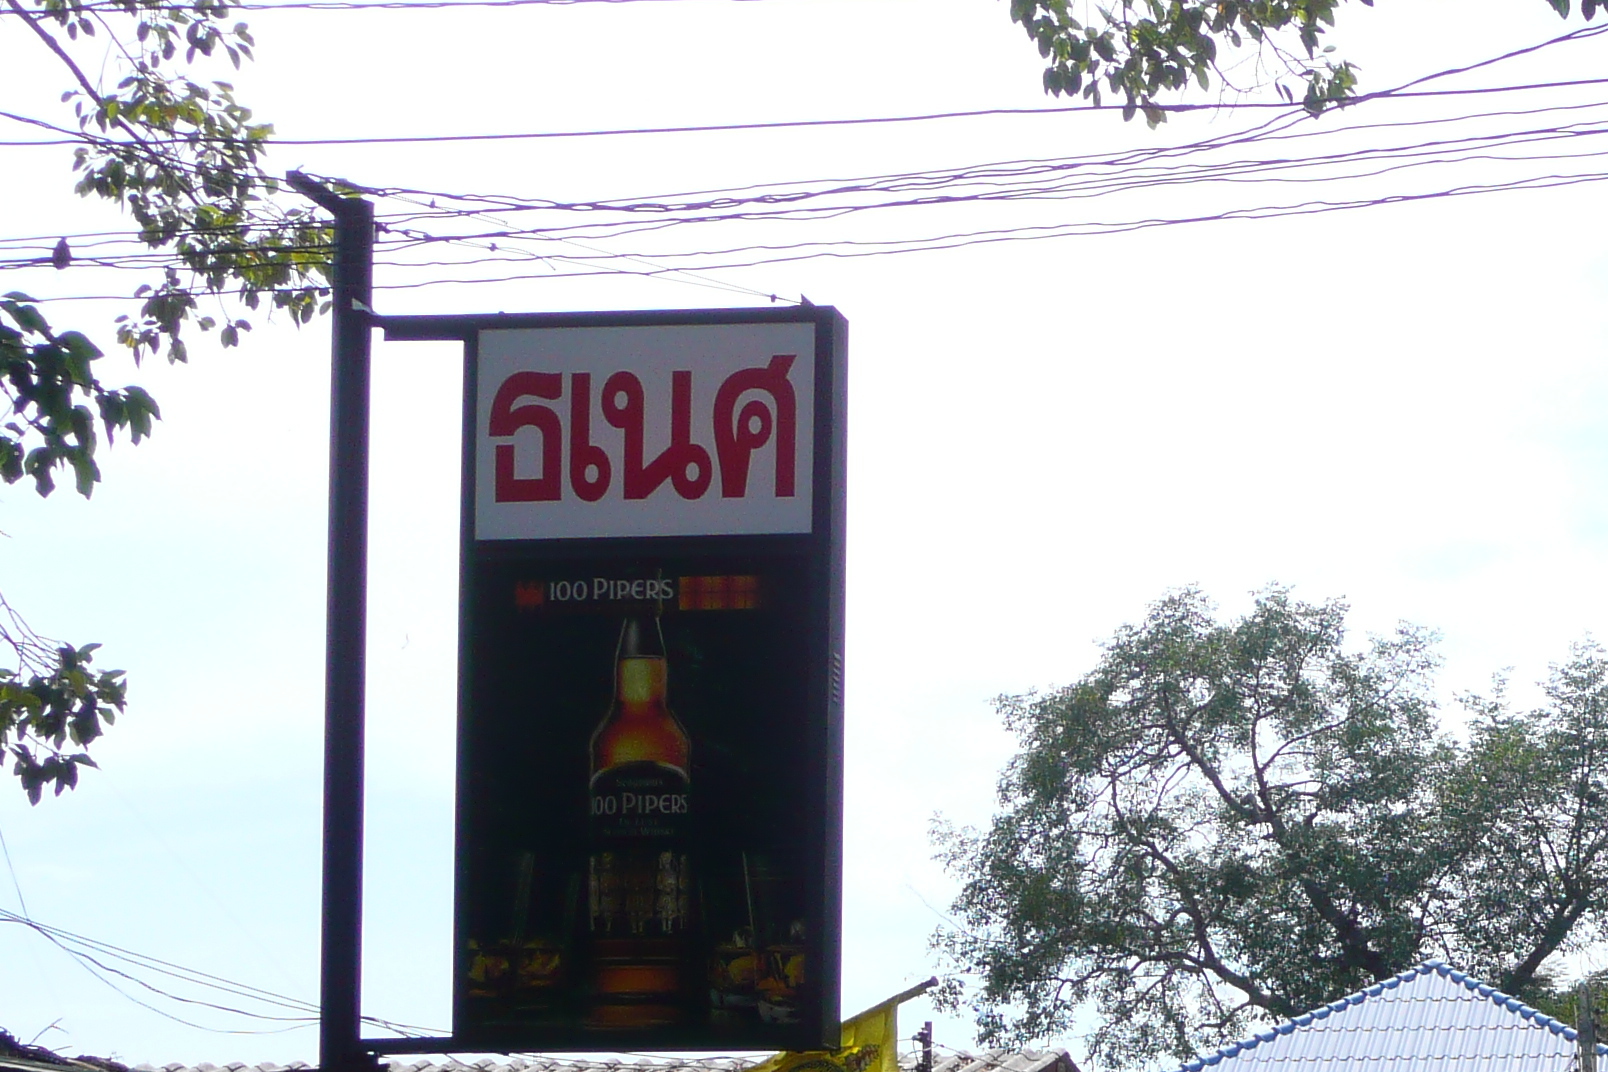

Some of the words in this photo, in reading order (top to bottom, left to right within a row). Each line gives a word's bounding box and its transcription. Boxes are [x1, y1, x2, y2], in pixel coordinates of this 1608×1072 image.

[488, 354, 798, 503] ธเนศ
[548, 580, 588, 602] 100
[592, 577, 674, 601] PIPERS
[621, 791, 688, 814] PIPERS
